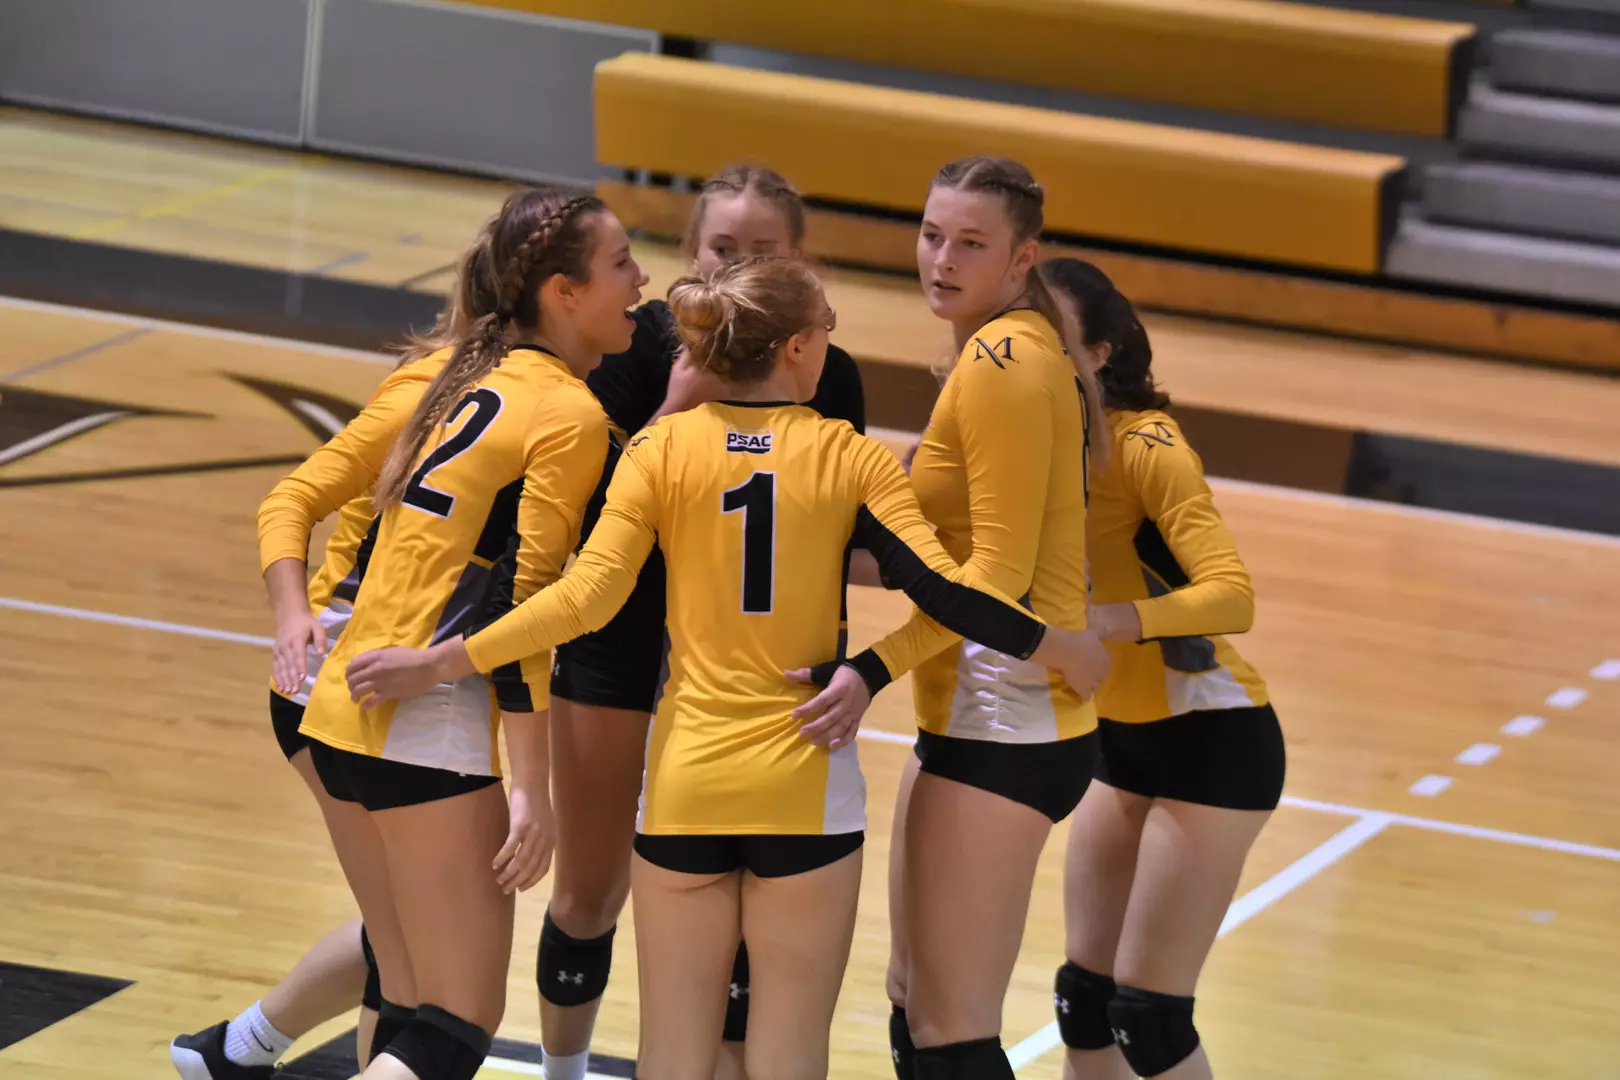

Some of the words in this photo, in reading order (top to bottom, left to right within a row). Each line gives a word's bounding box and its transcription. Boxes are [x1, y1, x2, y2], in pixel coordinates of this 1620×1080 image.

[401, 387, 504, 519] 2
[726, 432, 772, 447] PSAC
[722, 471, 775, 614] 1
